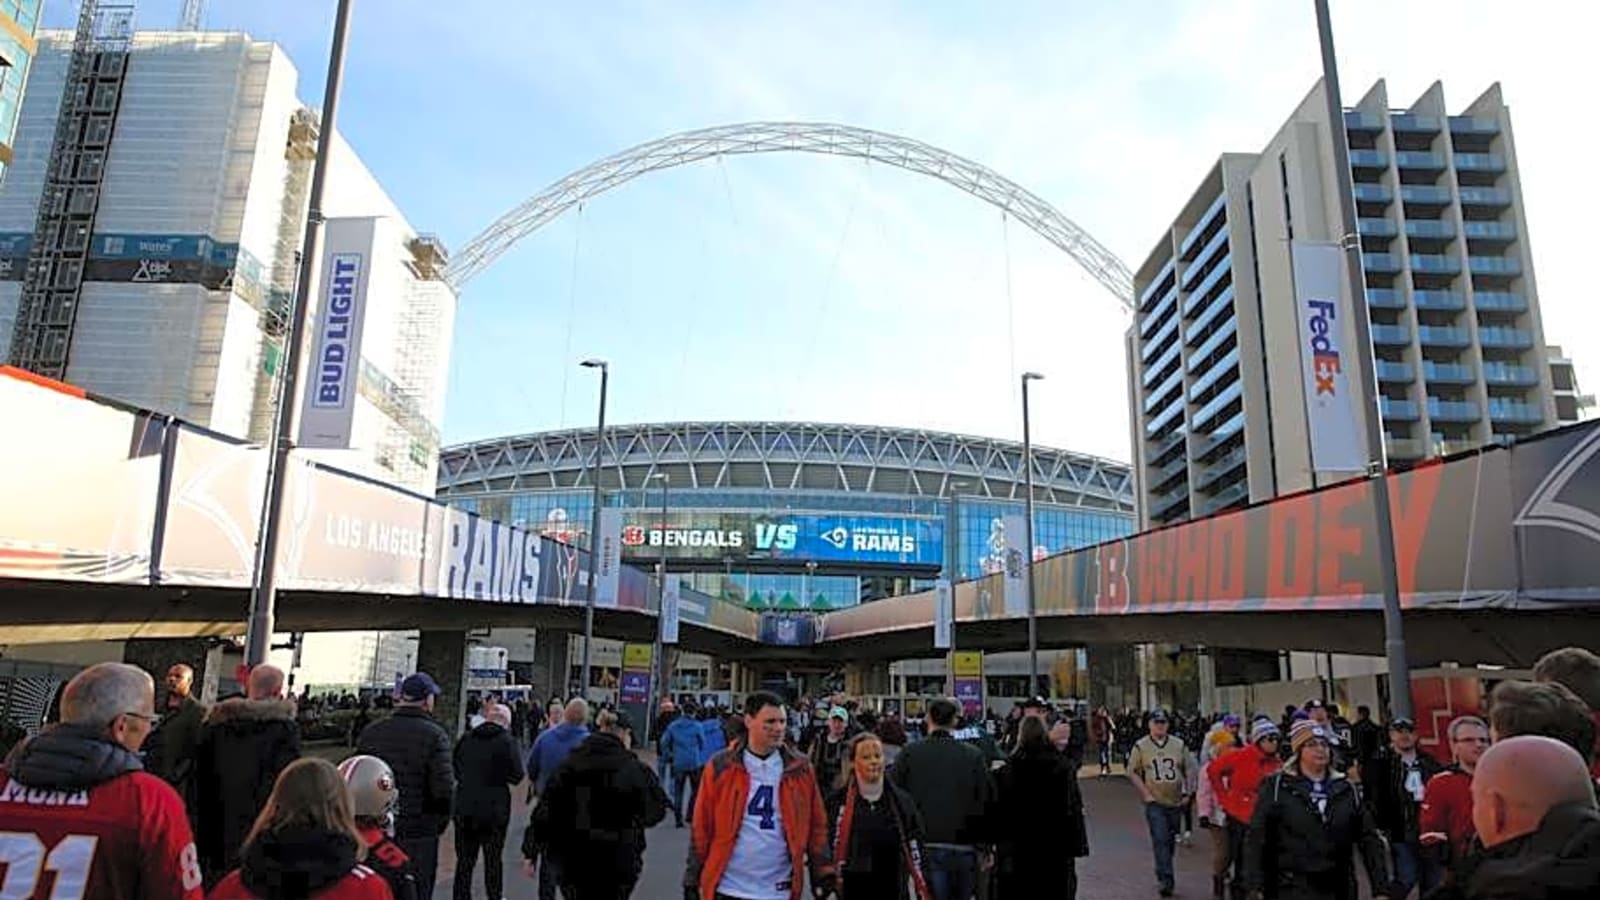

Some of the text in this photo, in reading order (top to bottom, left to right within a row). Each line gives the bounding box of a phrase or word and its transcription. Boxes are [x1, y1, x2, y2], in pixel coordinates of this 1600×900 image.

[328, 259, 355, 339] LIGHT
[319, 343, 345, 402] BUD
[1308, 300, 1341, 396] FedEx
[326, 512, 433, 561] LOS ANGELES
[438, 504, 541, 604] RAMS
[649, 530, 743, 547] BENGALS
[755, 523, 798, 550] VS
[852, 534, 914, 553] RAMS
[1137, 510, 1246, 611] WHO
[1263, 462, 1446, 610] DEY
[1151, 757, 1176, 781] 13
[747, 784, 775, 830] 4
